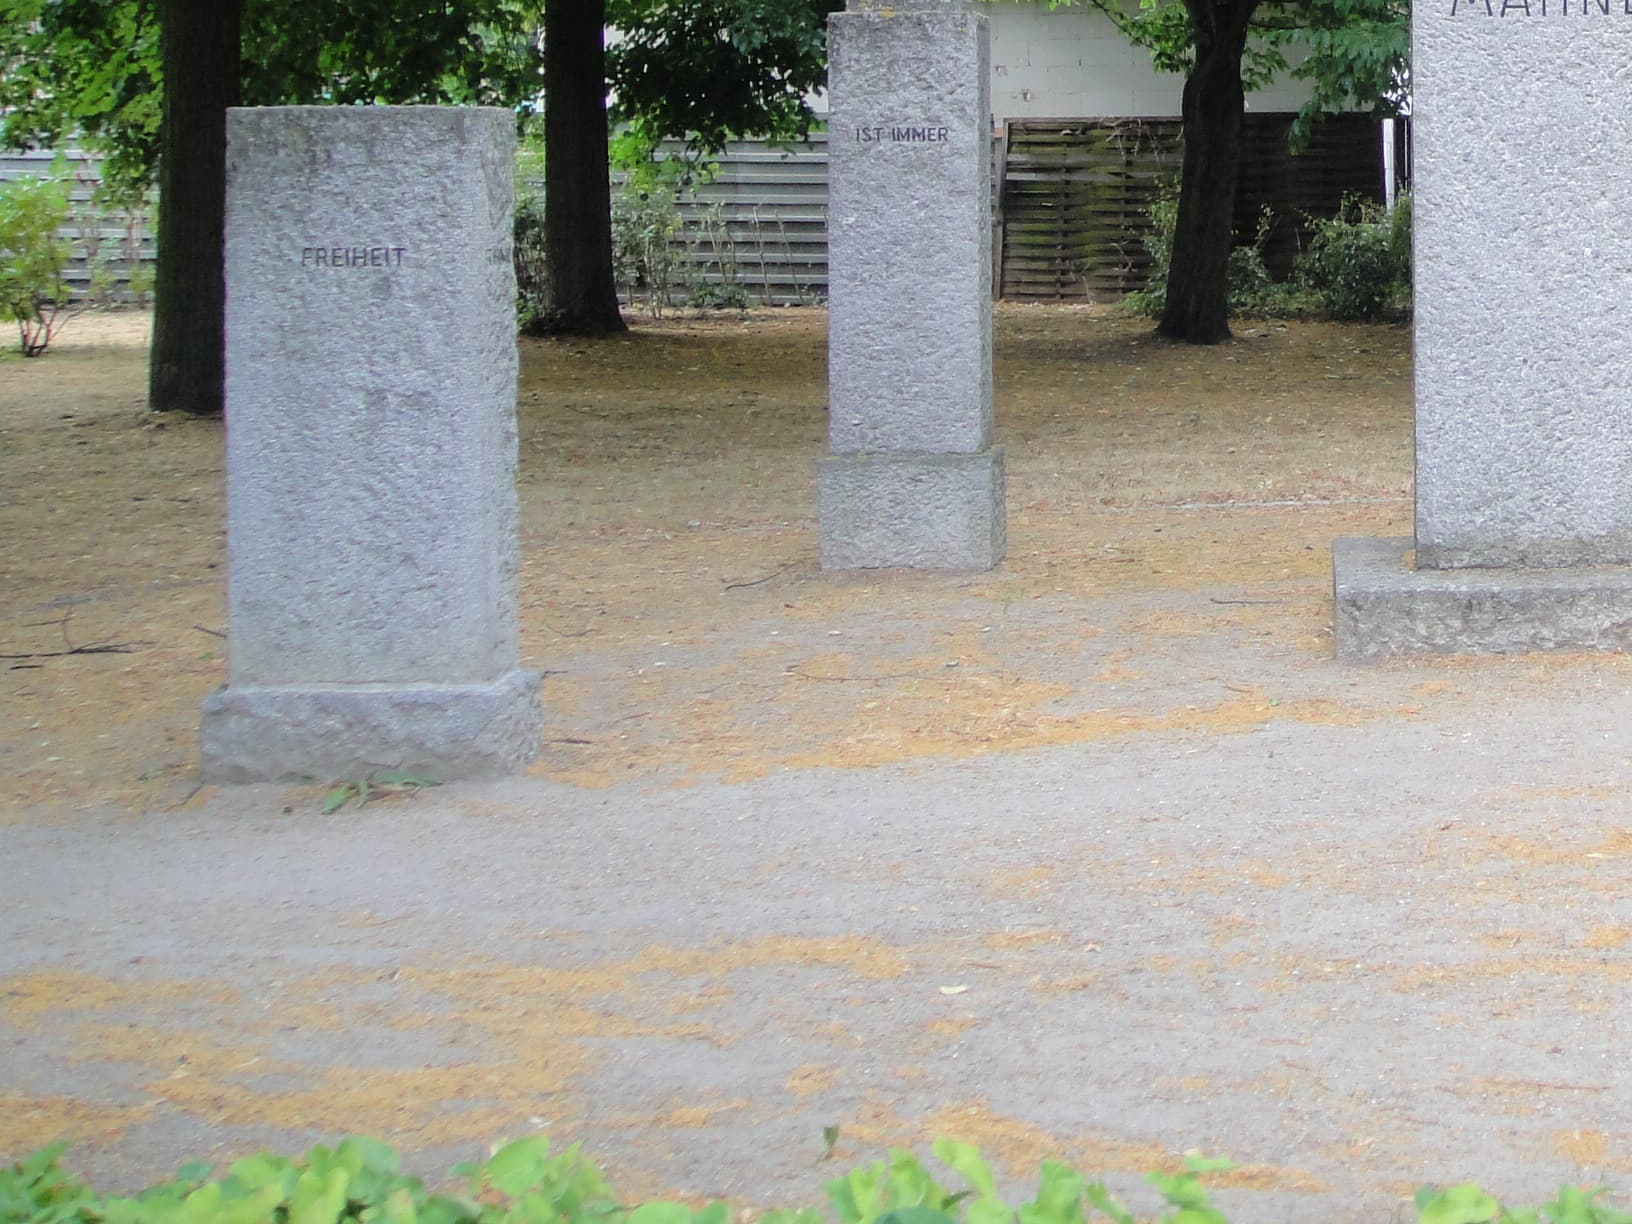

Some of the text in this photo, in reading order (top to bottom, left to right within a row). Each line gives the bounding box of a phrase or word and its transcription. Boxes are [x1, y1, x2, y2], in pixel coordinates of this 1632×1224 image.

[856, 127, 949, 142] IST IMMER
[301, 247, 407, 267] FREIHEIT
